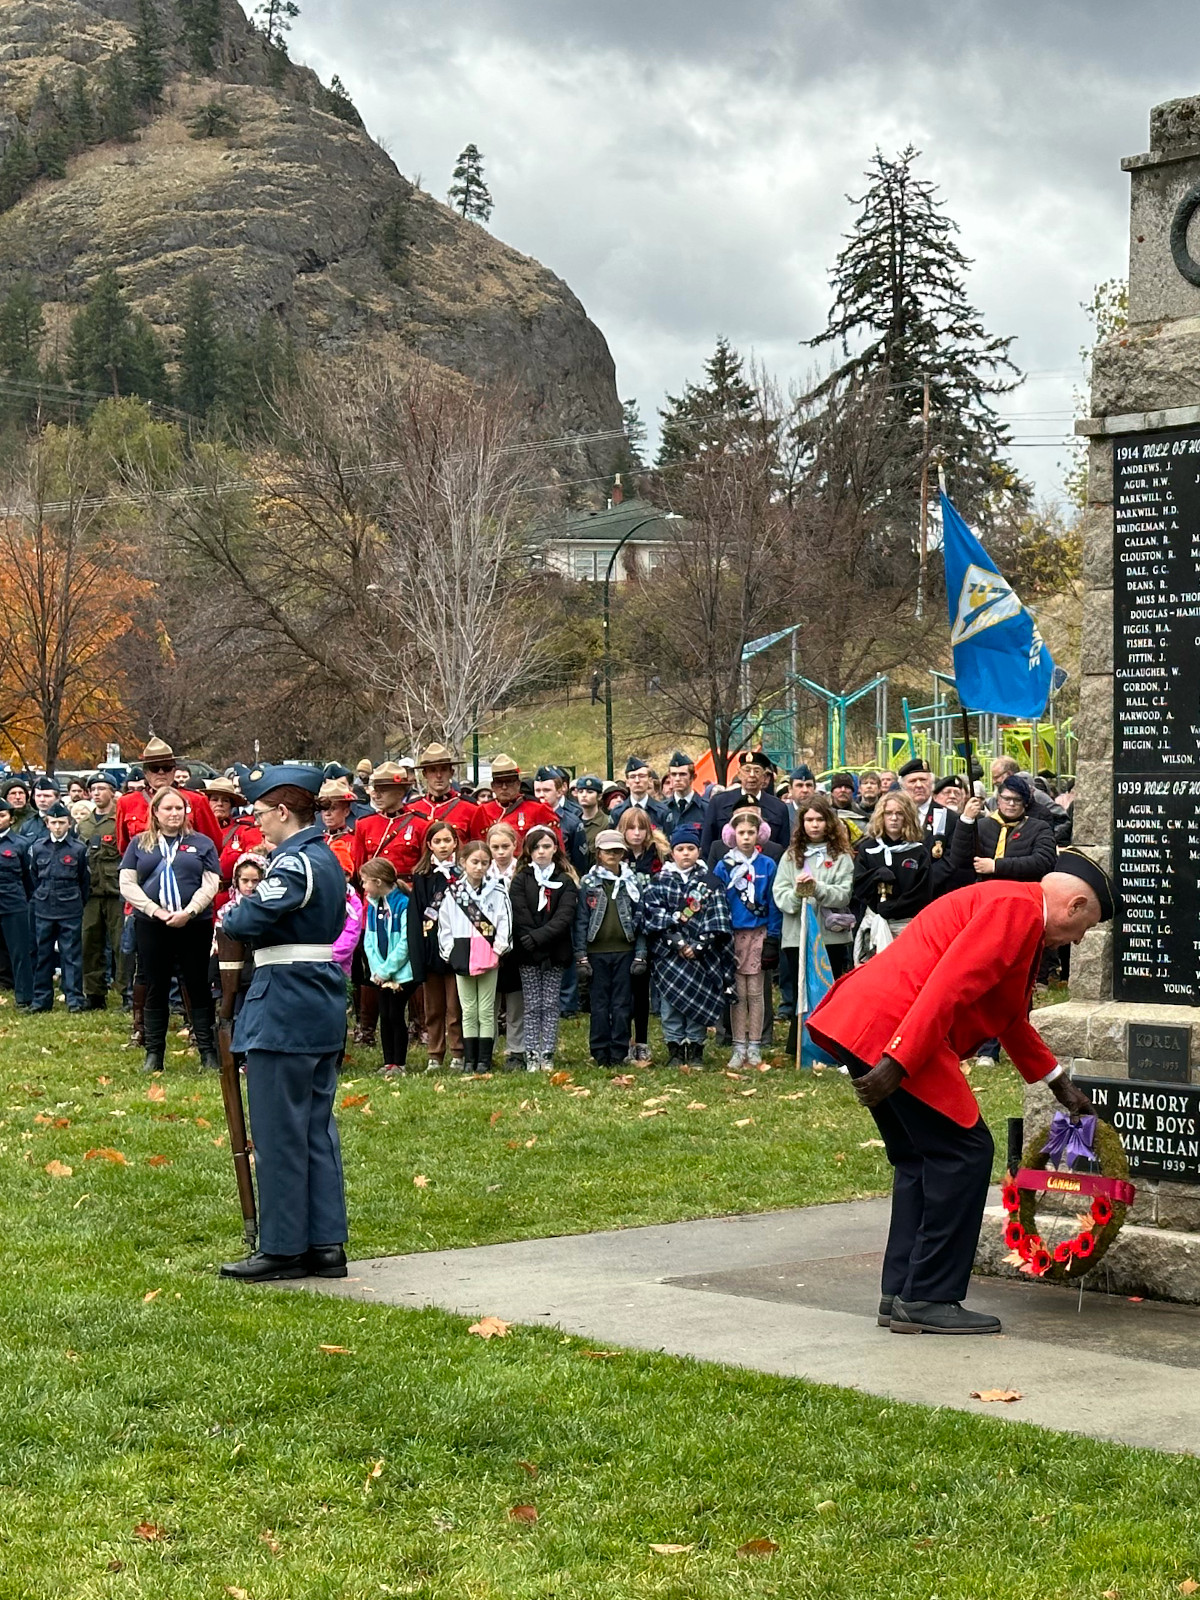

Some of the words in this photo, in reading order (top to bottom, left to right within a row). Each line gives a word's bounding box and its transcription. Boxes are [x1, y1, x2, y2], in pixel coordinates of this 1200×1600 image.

[1117, 447, 1139, 460] 1914
[1143, 442, 1170, 458] ROLL
[1172, 440, 1188, 455] OF
[1136, 595, 1155, 604] MISS
[1118, 782, 1141, 794] 1939
[1143, 781, 1170, 795] ROLL
[1173, 781, 1189, 795] OF
[1136, 1034, 1182, 1051] KOREA
[1092, 1089, 1108, 1105] IN
[1118, 1091, 1188, 1113] MEMORY
[1113, 1112, 1146, 1131] OUR
[1156, 1116, 1194, 1135] BOYS
